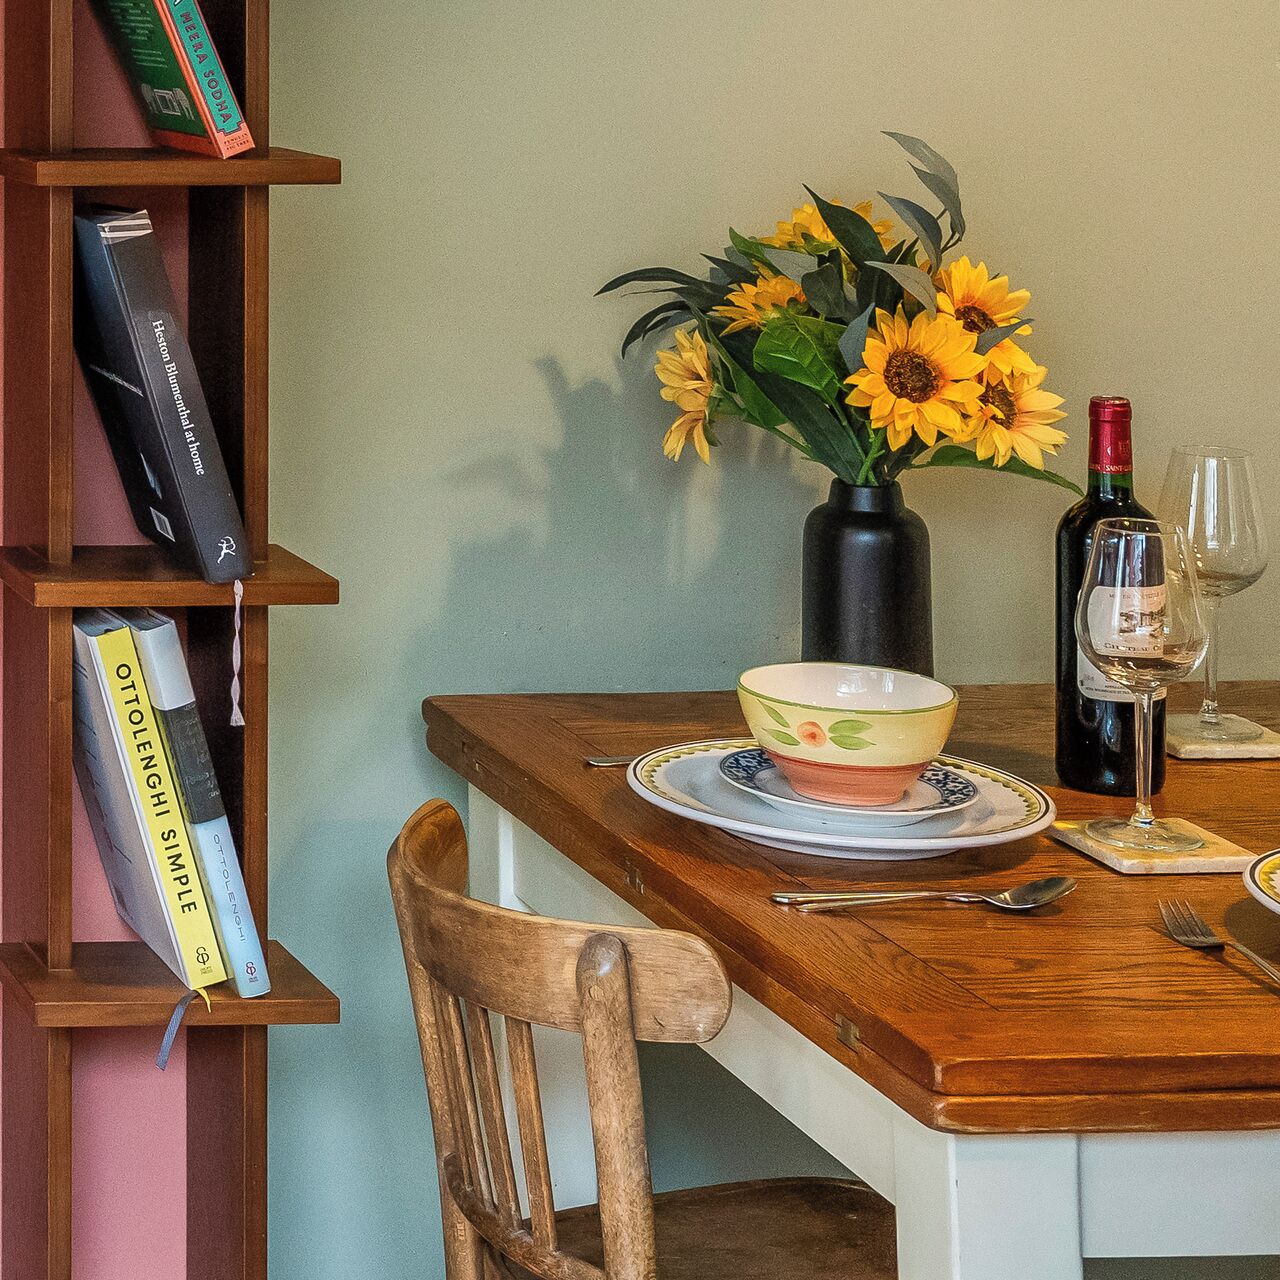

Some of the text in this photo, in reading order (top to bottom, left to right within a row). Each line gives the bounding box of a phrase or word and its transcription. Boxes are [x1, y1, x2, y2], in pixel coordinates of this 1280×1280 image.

[178, 10, 209, 64] MEERA
[202, 68, 233, 124] SODHA
[150, 319, 206, 476] Heston Blumenthal at home
[111, 661, 198, 915] OTTOLENGHI SIMPLE
[211, 833, 246, 942] OTTOLENGHI
